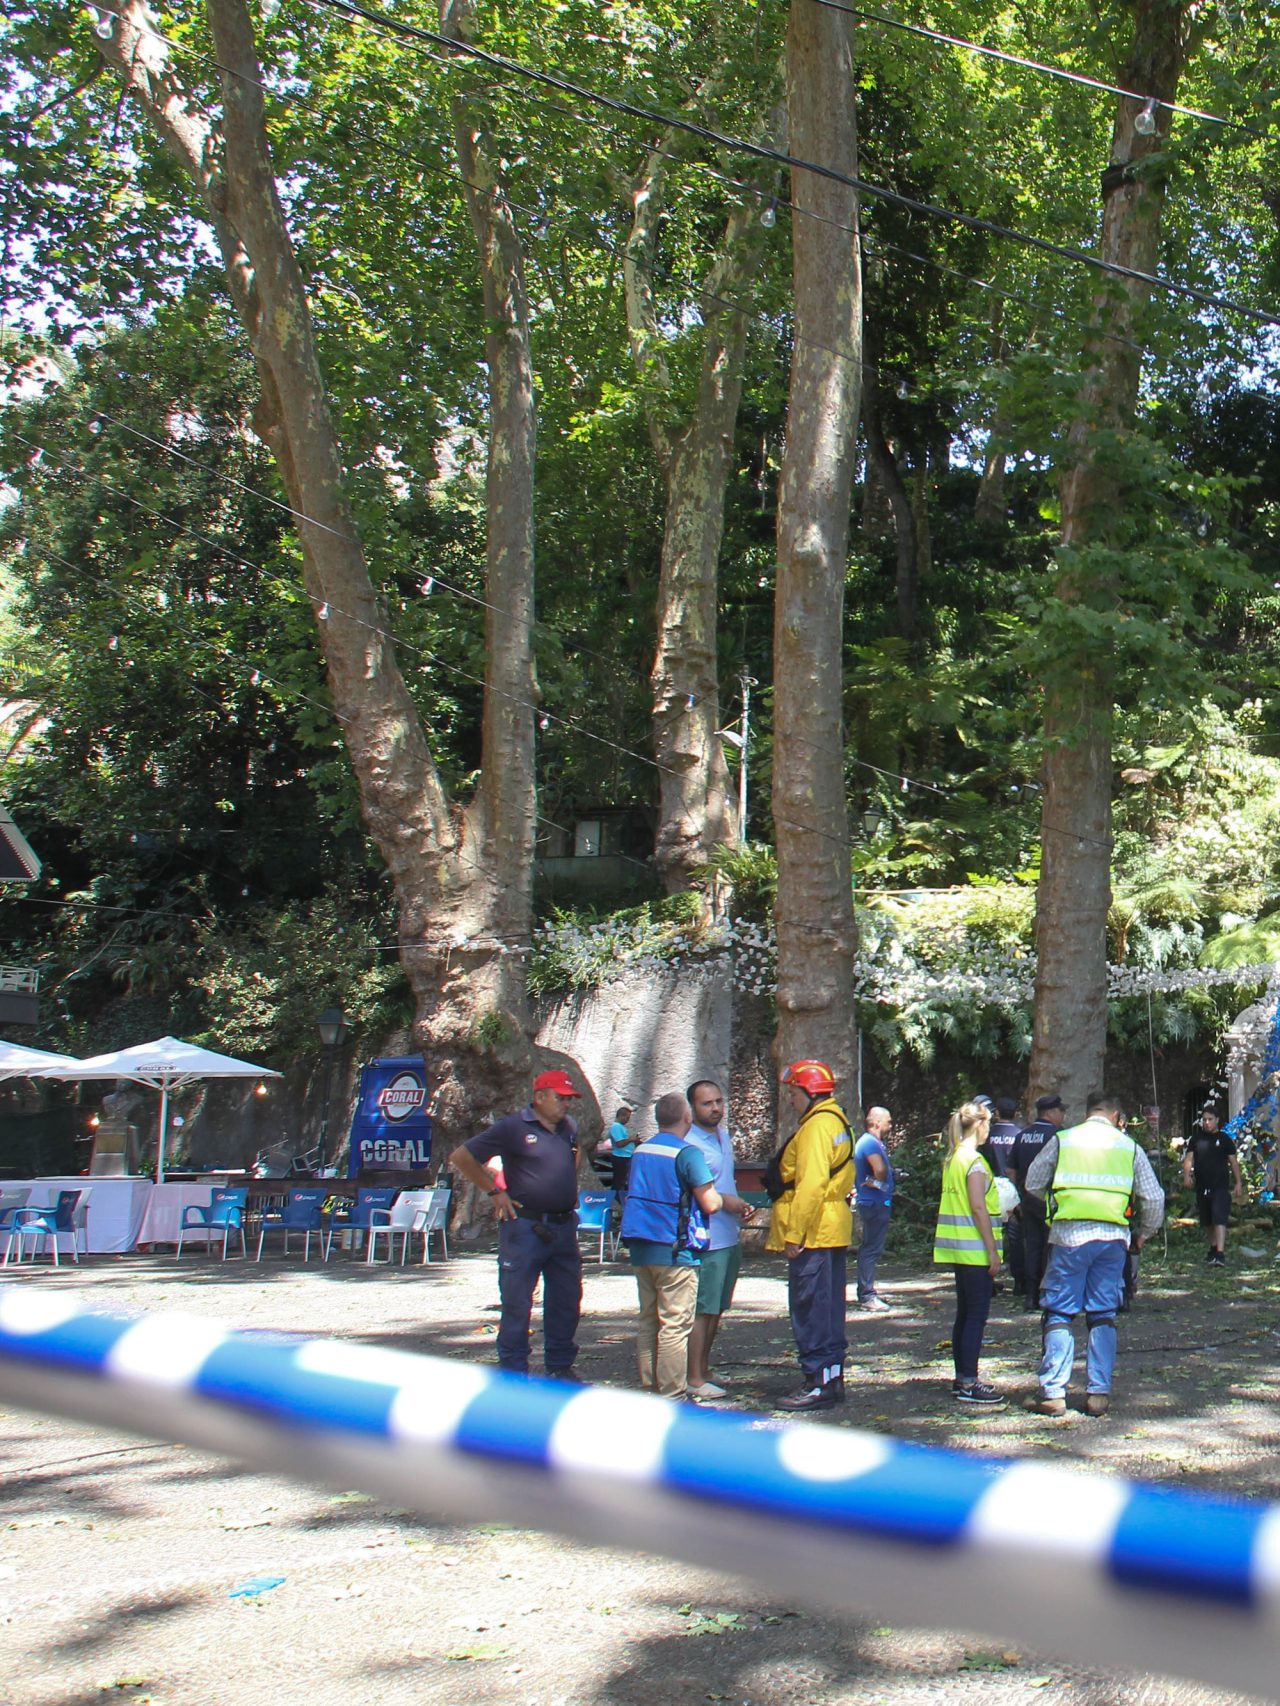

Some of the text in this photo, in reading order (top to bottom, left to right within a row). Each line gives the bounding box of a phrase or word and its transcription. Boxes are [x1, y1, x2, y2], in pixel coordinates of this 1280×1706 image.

[385, 1091, 420, 1103] CORAL
[1021, 1130, 1044, 1144] POLÍCIA
[360, 1139, 430, 1162] CORAL
